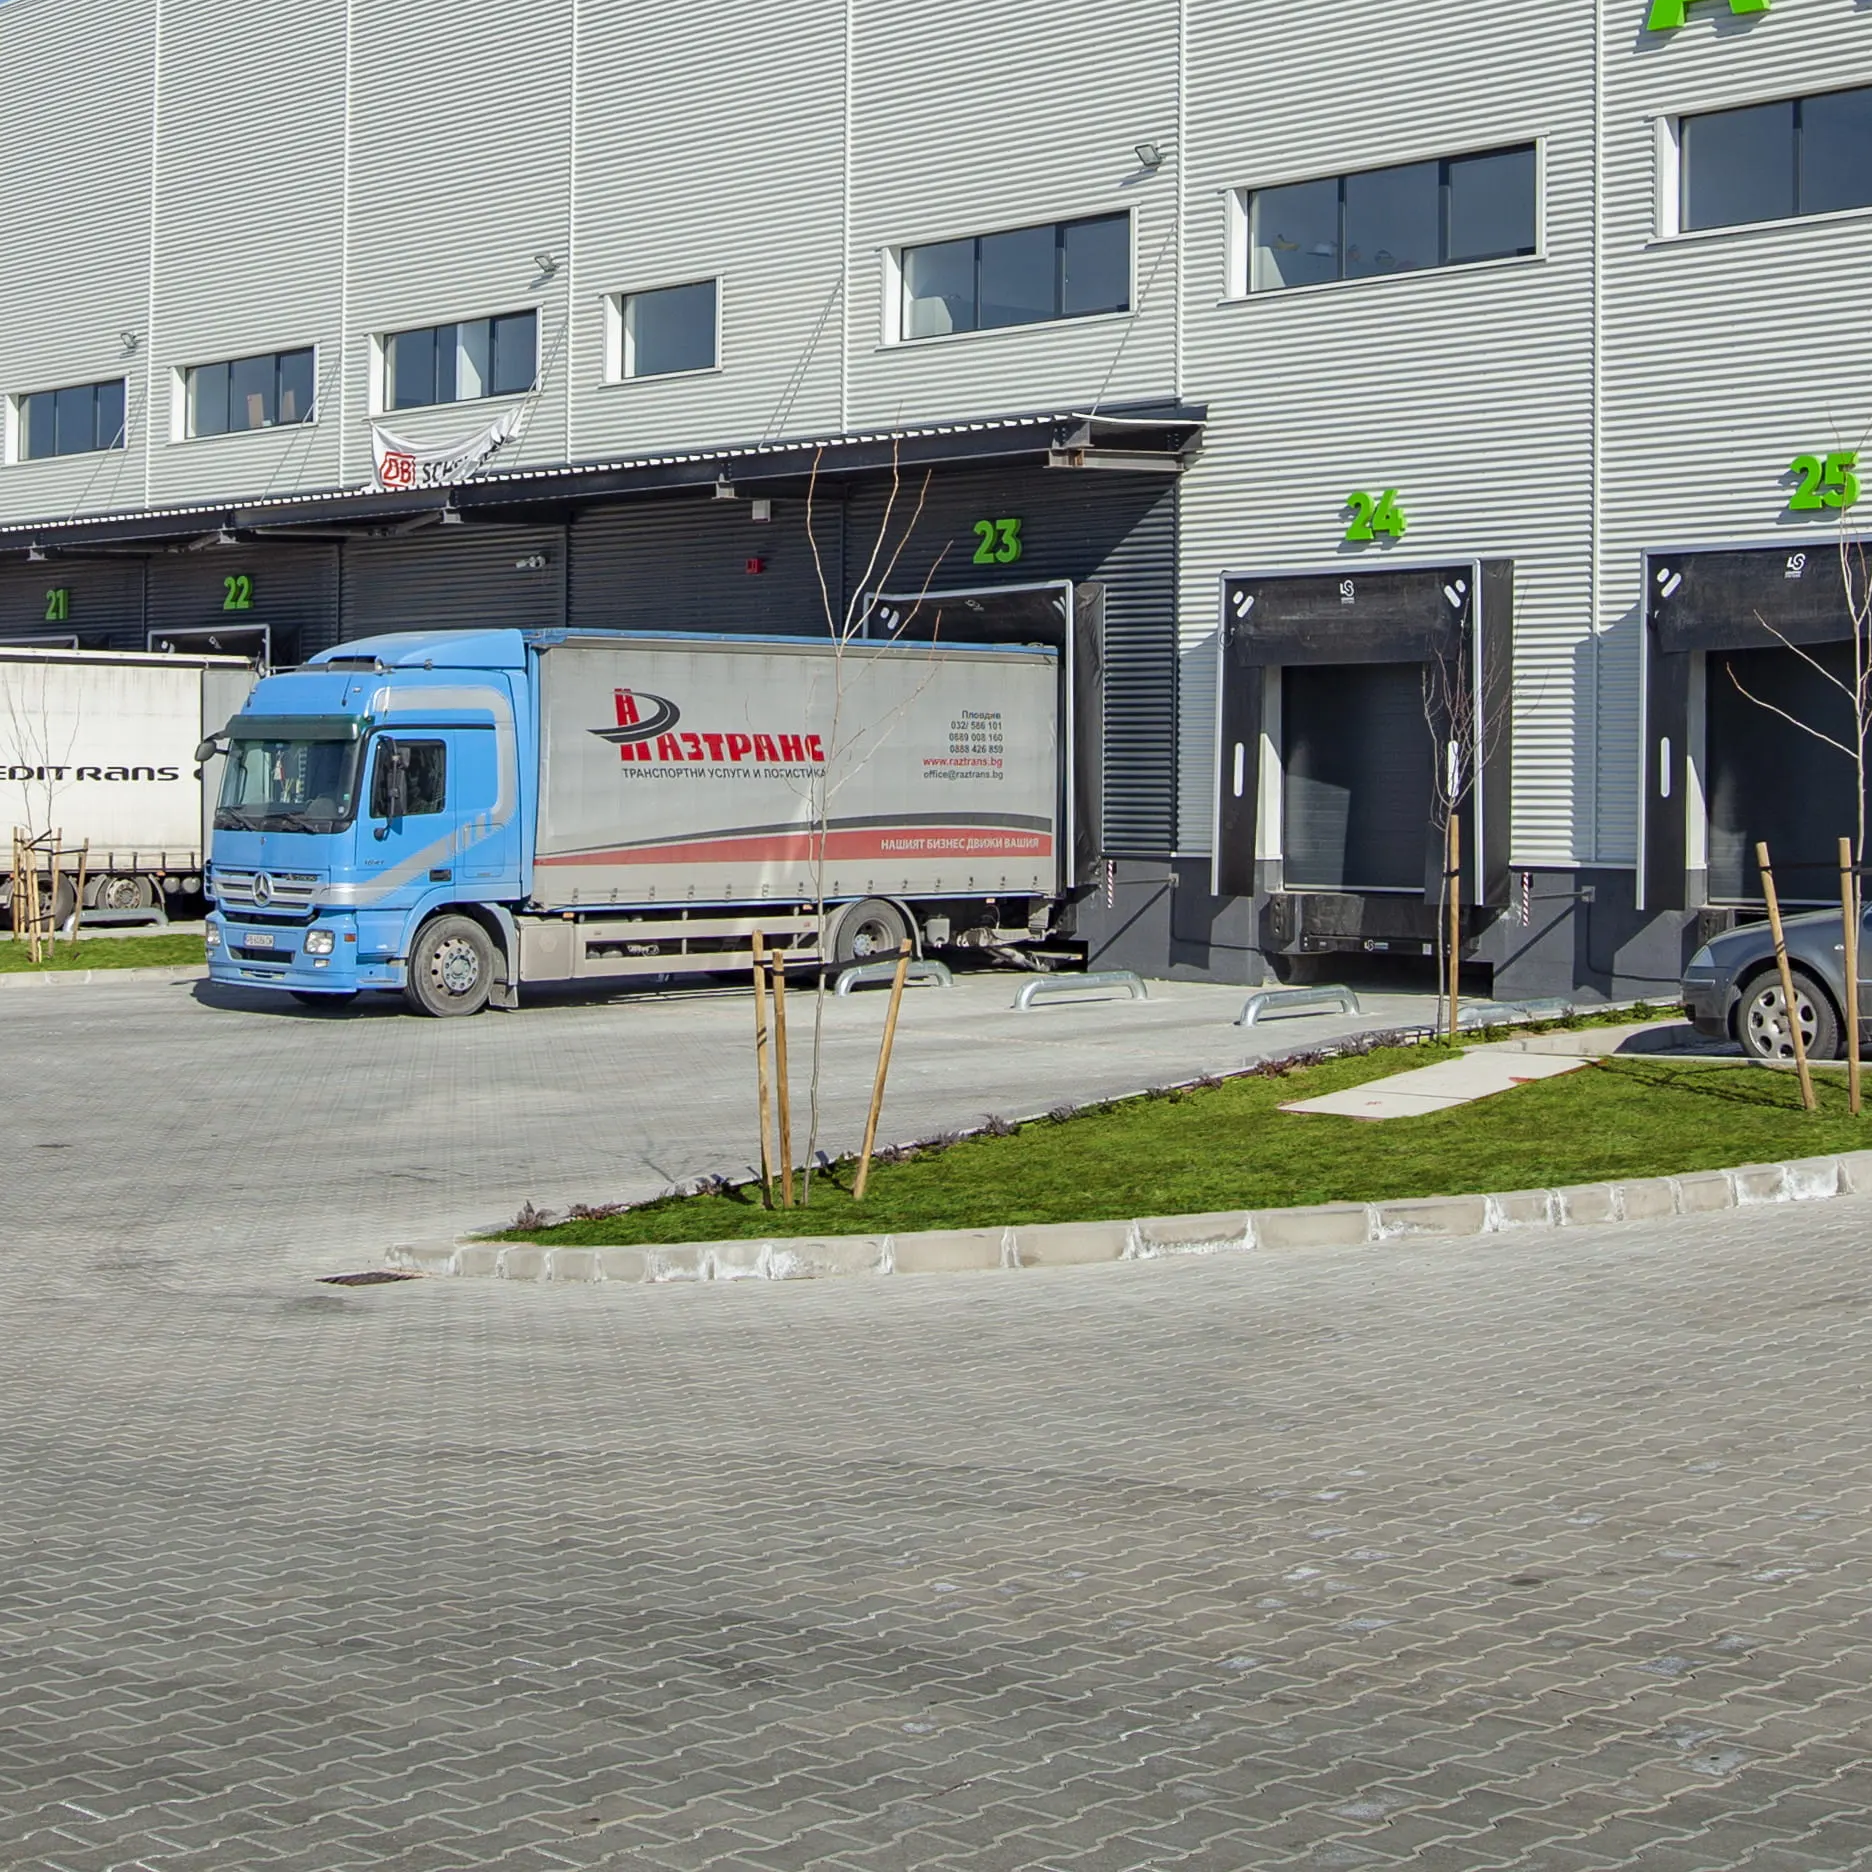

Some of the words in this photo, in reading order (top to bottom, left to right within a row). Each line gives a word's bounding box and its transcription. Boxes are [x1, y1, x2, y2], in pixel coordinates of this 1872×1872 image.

[384, 458, 412, 484] DB
[1789, 451, 1861, 510] 25
[1345, 488, 1407, 540] 24
[973, 518, 1021, 564] 23
[45, 589, 69, 621] 21
[223, 575, 253, 610] 22
[988, 721, 1002, 730] 101
[622, 767, 705, 779] ТРАНСПОРТНИ
[708, 767, 751, 779] УСЛУГИ
[753, 767, 761, 779] И
[923, 757, 1003, 768] www.raztrans.bg
[923, 769, 1004, 780] office@raztrans.bg
[881, 839, 926, 850] НАШИЯТ
[927, 838, 965, 849] БИЗНЕС
[966, 838, 1002, 850] ДВИЖИ
[1004, 838, 1039, 849] ВАШИЯ
